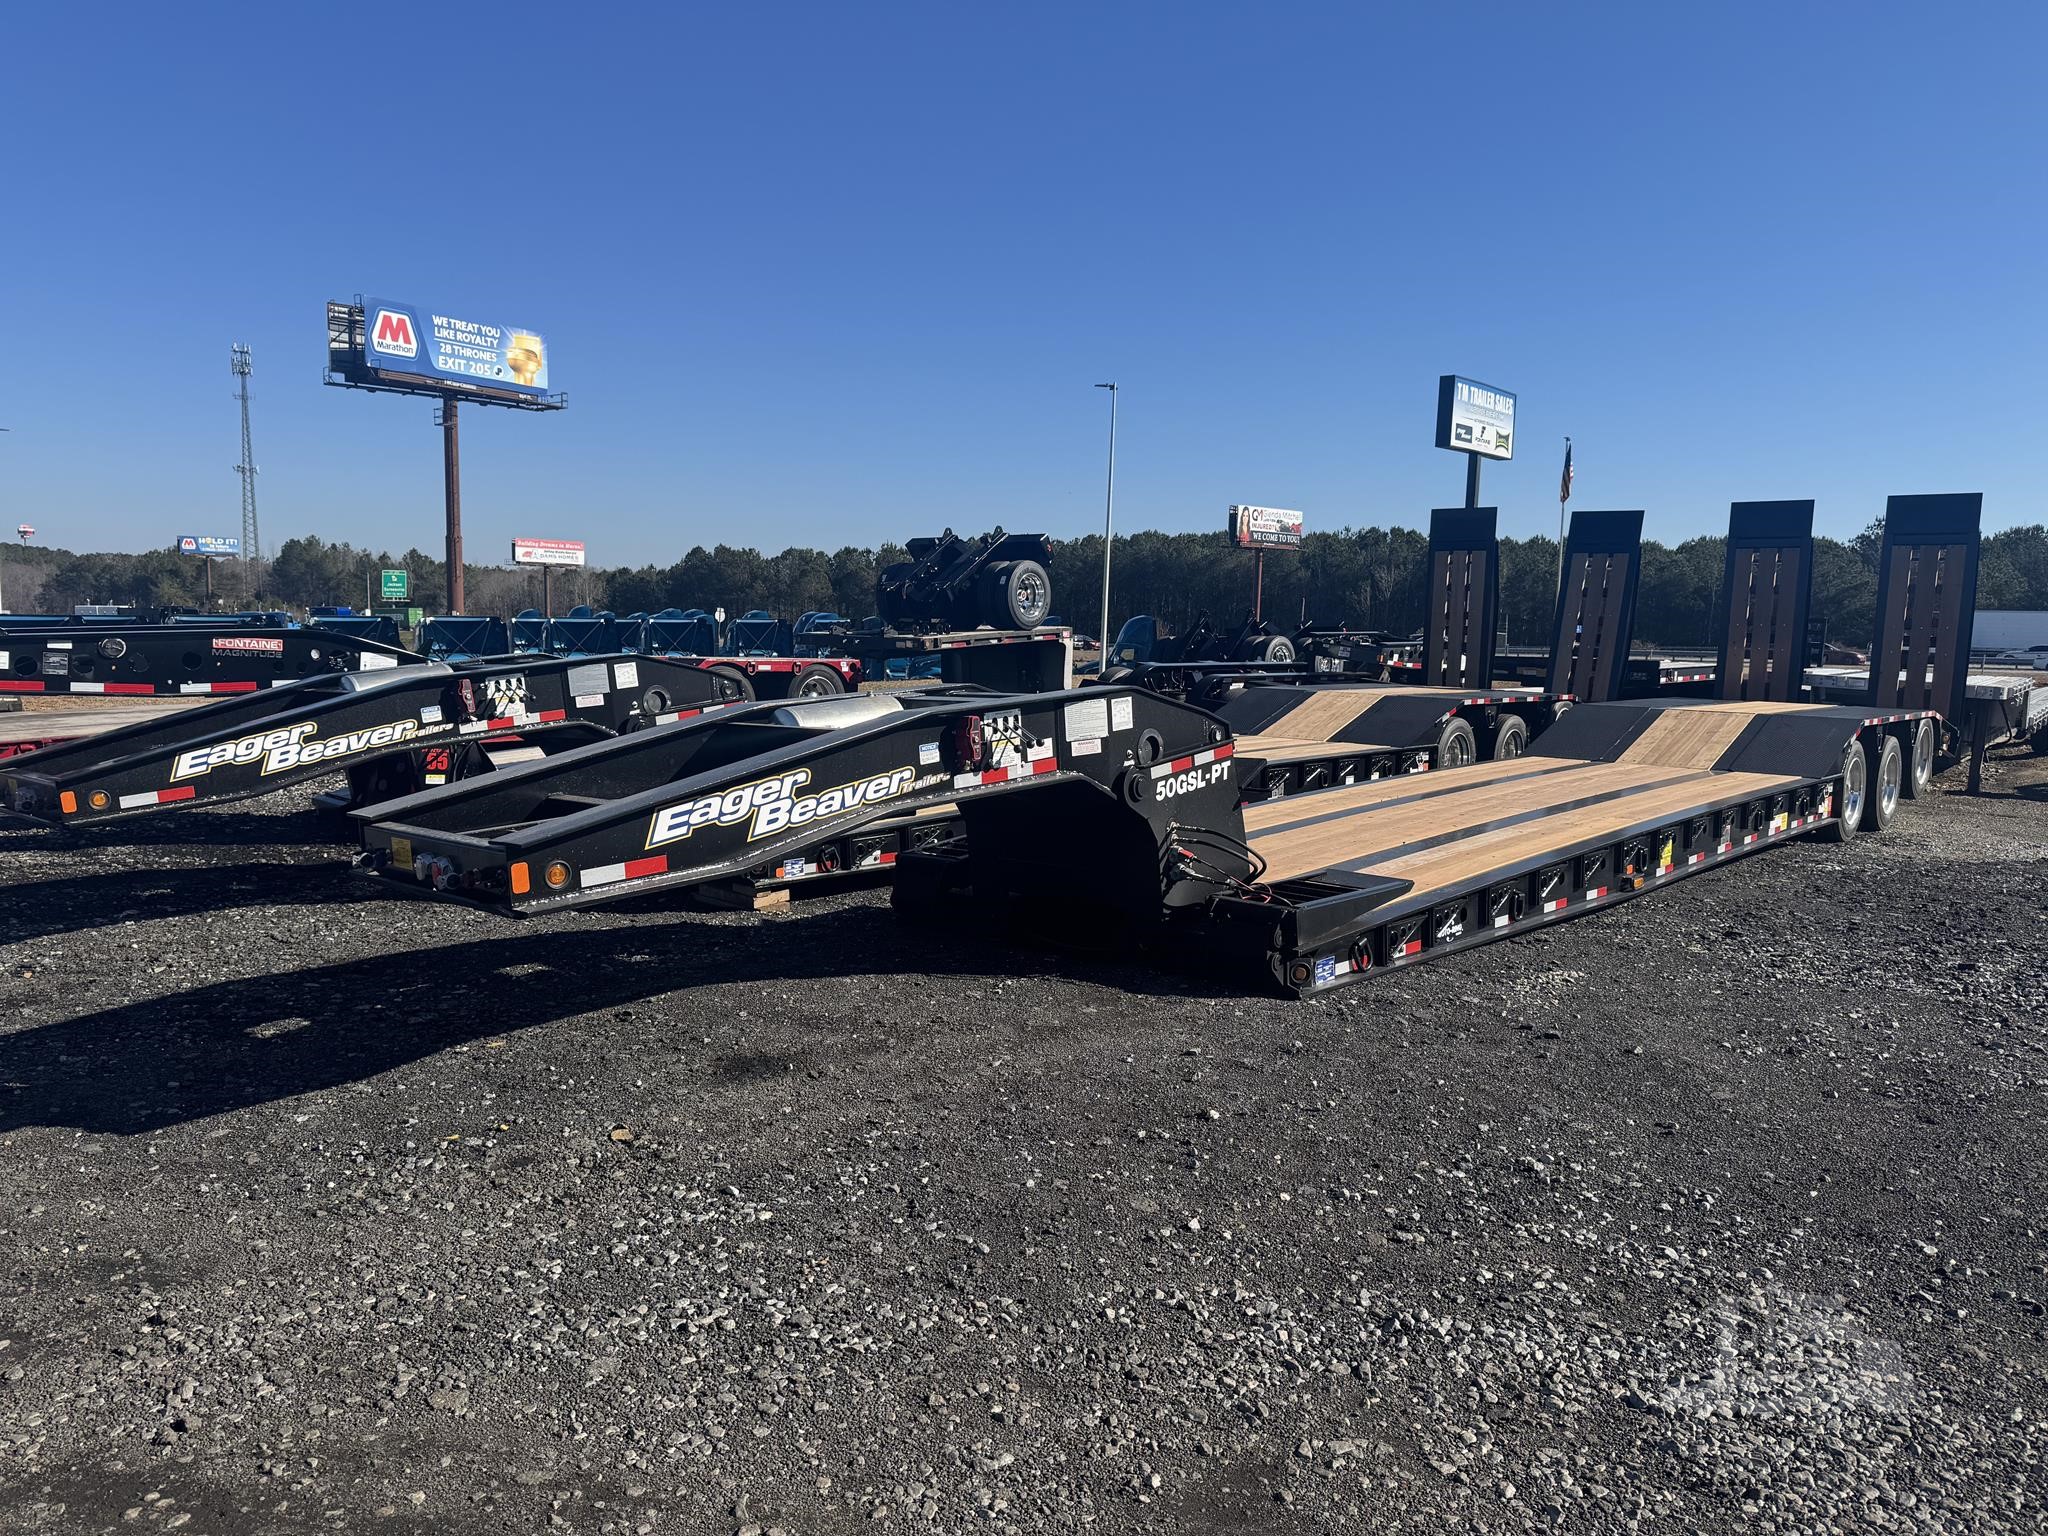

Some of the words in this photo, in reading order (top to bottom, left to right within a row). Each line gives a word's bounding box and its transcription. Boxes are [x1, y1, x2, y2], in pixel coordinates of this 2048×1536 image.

[377, 314, 412, 345] M
[432, 315, 448, 327] WE
[449, 319, 479, 333] TREAT
[480, 325, 500, 338] YOU
[376, 341, 414, 354] Marathon
[434, 327, 455, 339] LIKE
[456, 331, 498, 348] ROYALTY
[440, 343, 452, 354] 28
[454, 346, 497, 362] THRONES
[438, 355, 467, 371] EXIT
[468, 361, 491, 375] 205
[1470, 387, 1495, 409] TRAILER
[1495, 394, 1513, 415] SALES
[1253, 532, 1261, 540] WE
[1262, 533, 1278, 542] COME
[1279, 535, 1287, 543] TO
[212, 649, 283, 659] MAGNITUDE
[218, 639, 278, 650] FONTAINE
[170, 722, 317, 782] Eager
[261, 719, 418, 776] Beaver
[1155, 760, 1231, 801] 50GSL-PT
[645, 768, 811, 850] Eager
[747, 766, 915, 843] Beaver
